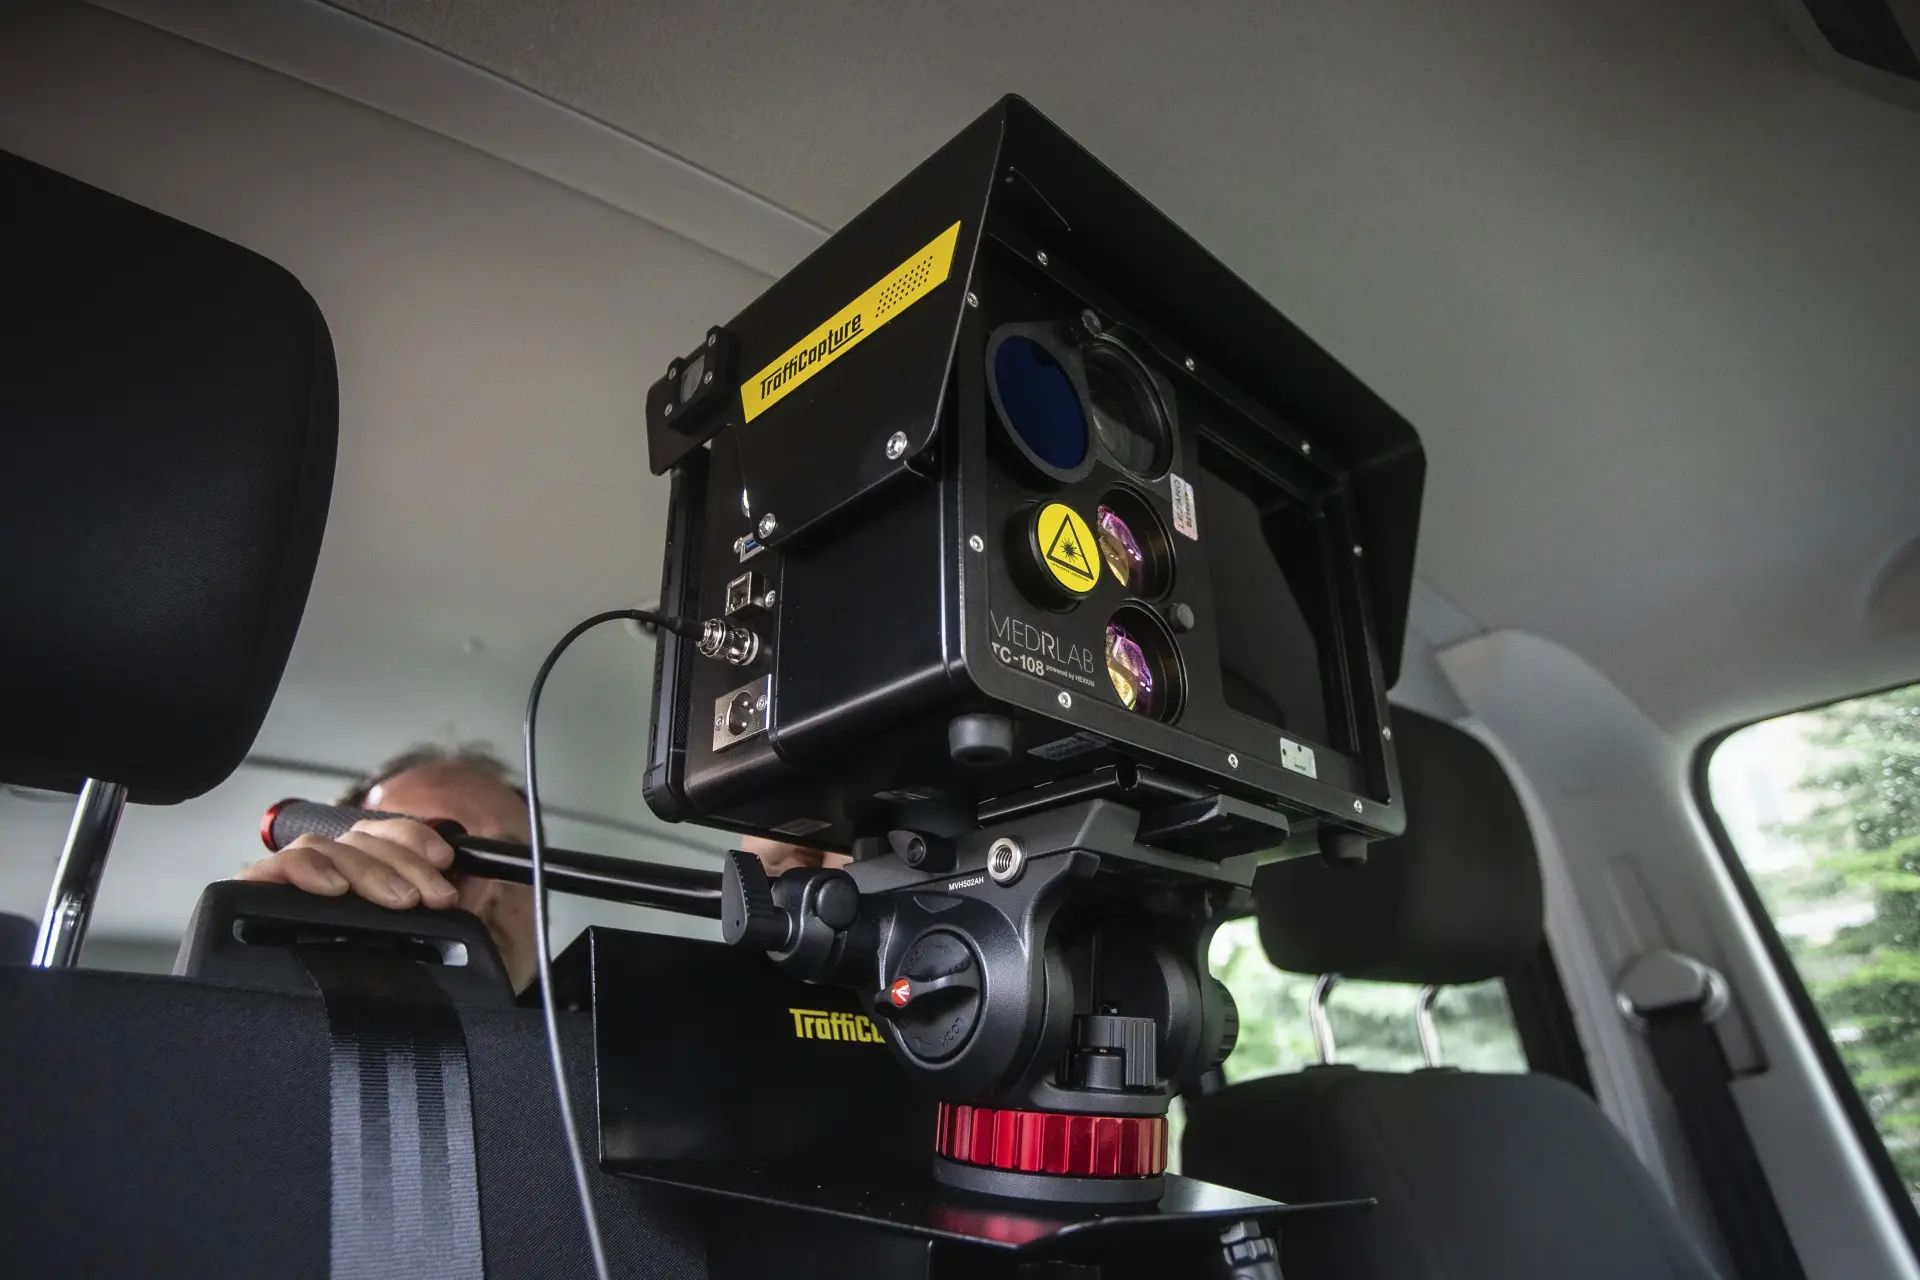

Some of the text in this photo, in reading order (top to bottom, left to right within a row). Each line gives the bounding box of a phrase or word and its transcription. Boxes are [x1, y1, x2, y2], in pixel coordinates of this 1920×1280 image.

[760, 313, 864, 400] TraffiCapture
[991, 642, 1045, 676] TC-108
[1046, 664, 1068, 678] powered
[948, 876, 985, 891] MVH502AH
